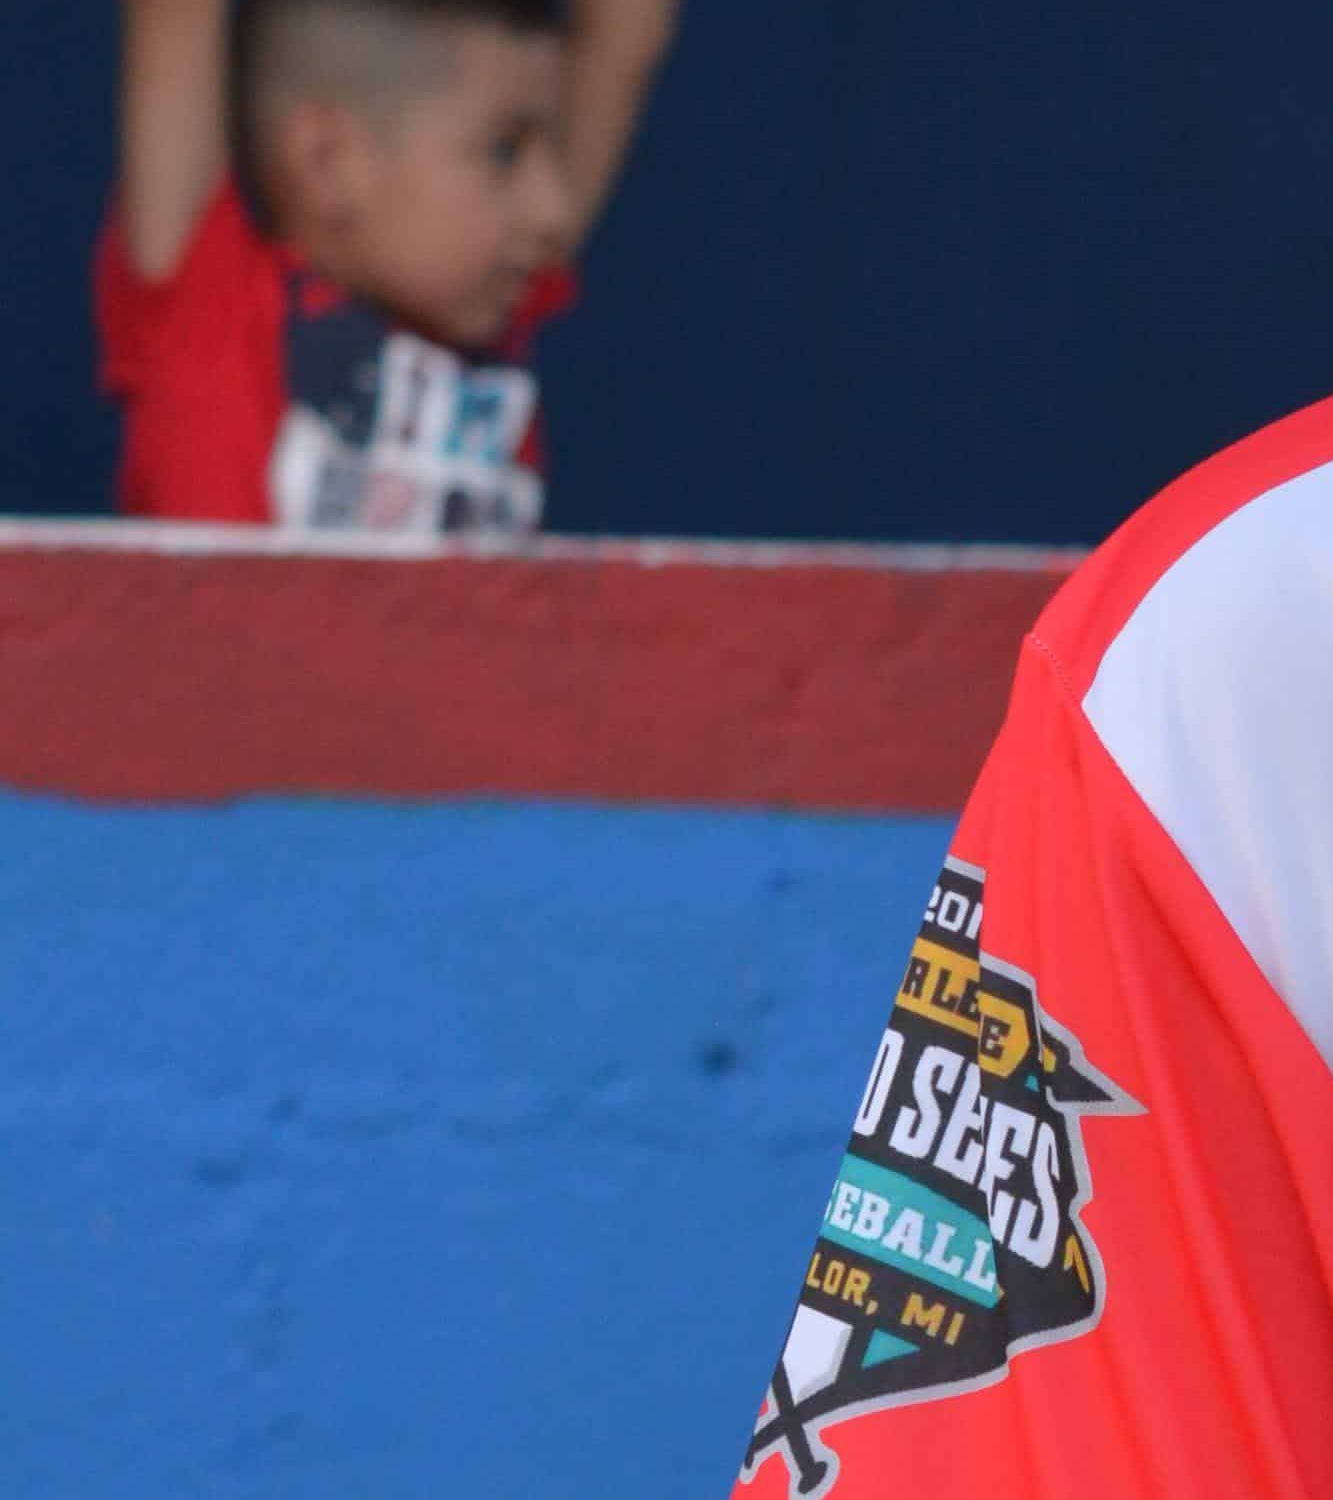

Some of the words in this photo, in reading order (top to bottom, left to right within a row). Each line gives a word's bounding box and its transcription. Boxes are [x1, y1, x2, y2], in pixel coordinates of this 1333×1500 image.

[822, 1180, 998, 1294] EBALL
[805, 1250, 880, 1317] LOR,
[900, 1292, 967, 1347] MI
